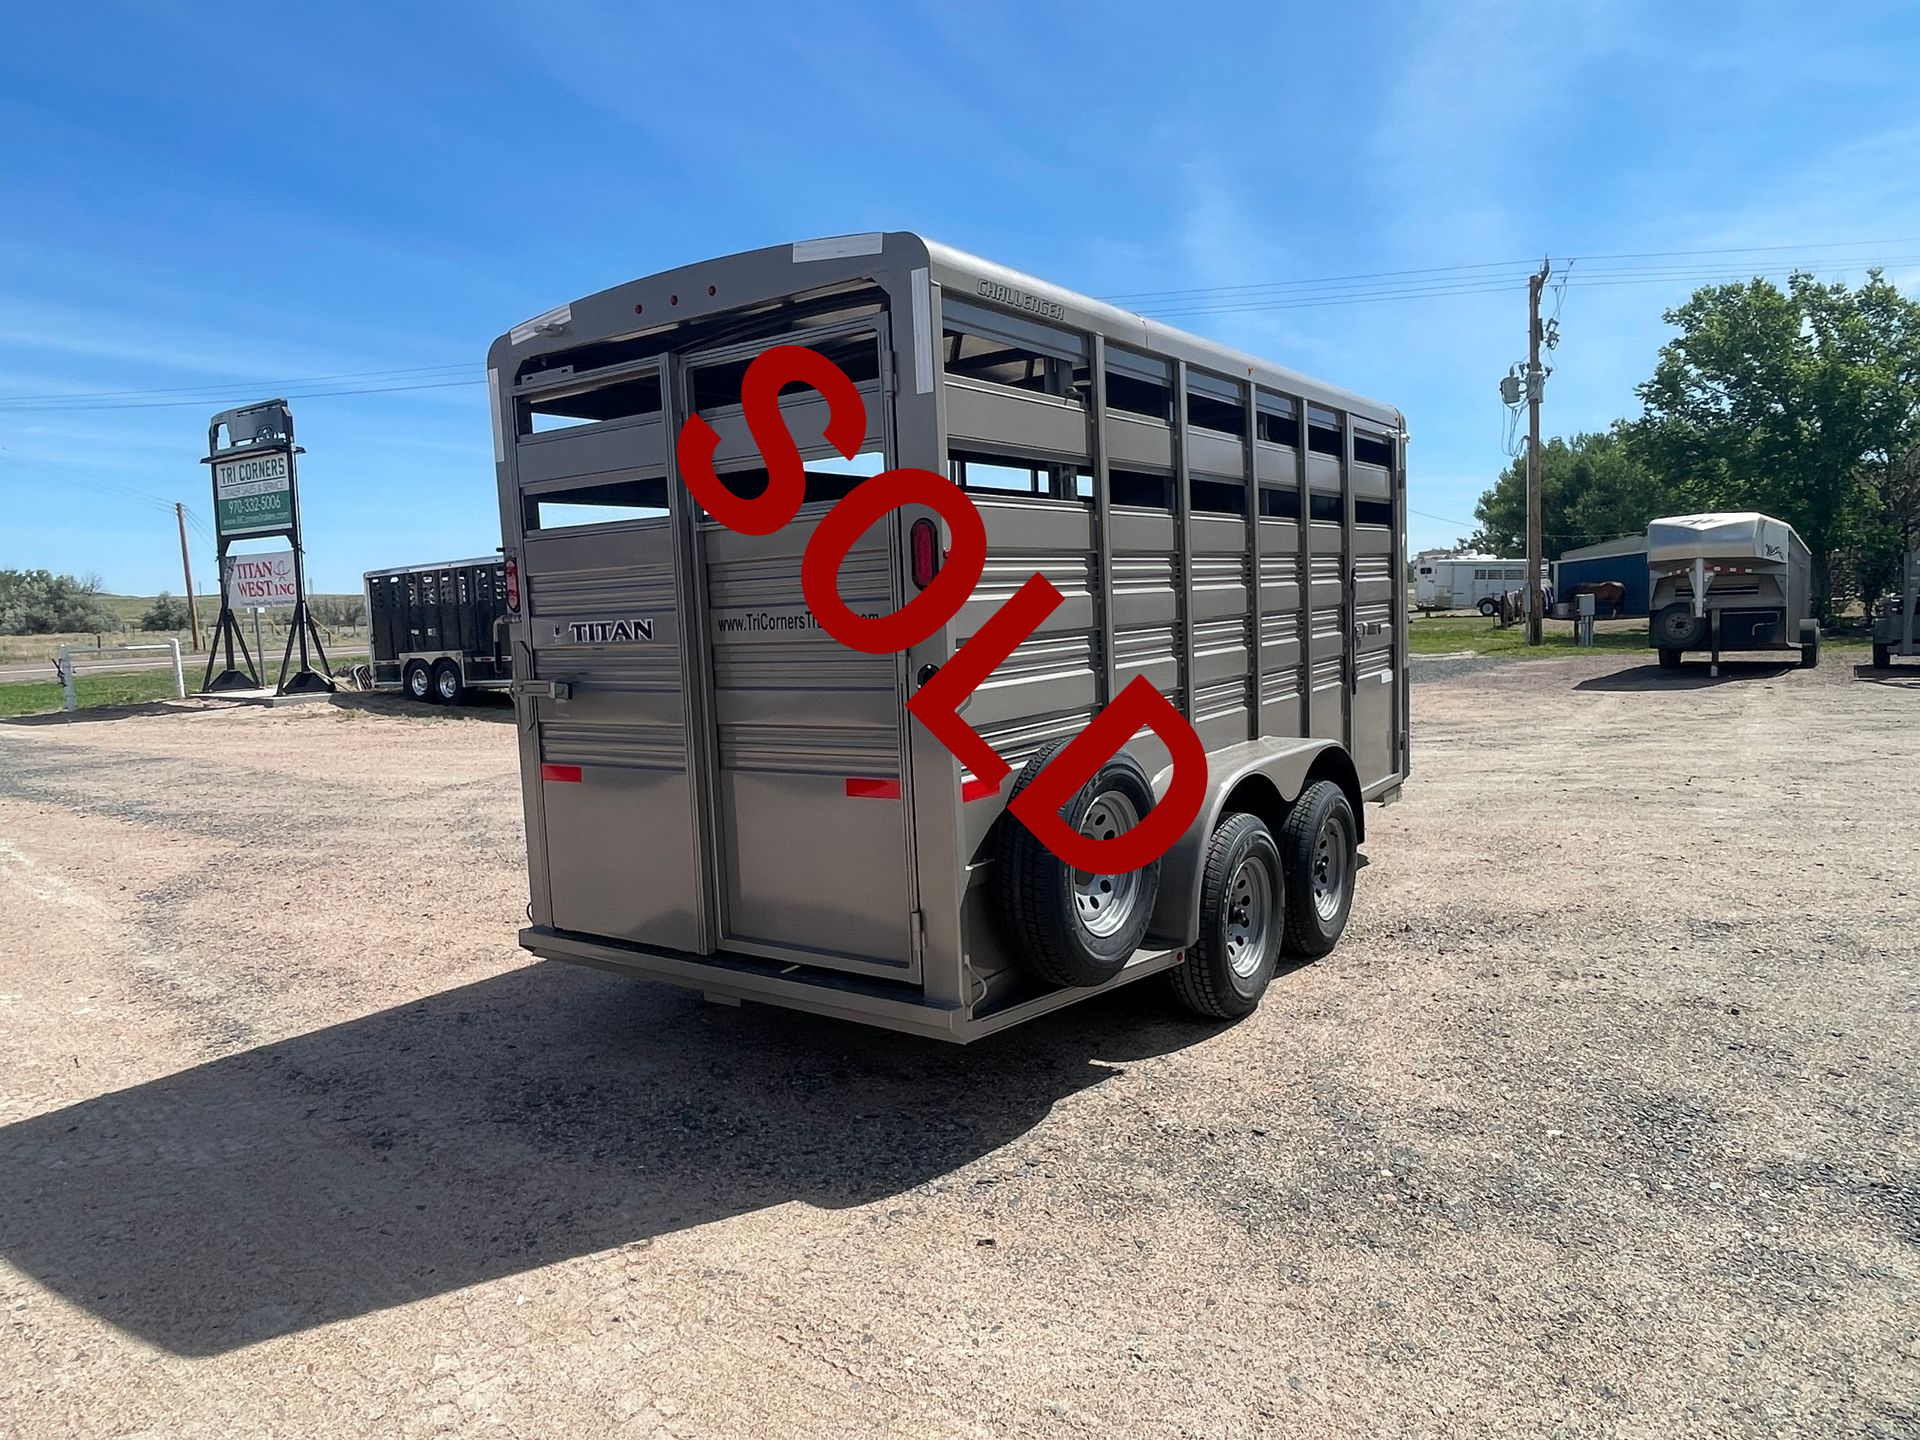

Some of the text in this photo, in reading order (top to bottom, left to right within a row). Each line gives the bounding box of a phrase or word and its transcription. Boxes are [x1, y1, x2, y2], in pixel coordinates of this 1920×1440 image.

[977, 278, 1065, 320] CHALLENGER
[220, 458, 285, 484] TRI CORNERS
[228, 494, 281, 514] 970-332-5006
[236, 561, 273, 579] TITAN
[237, 580, 295, 597] WEST INC
[568, 619, 655, 643] TITAN
[718, 611, 879, 632] www.TriCornersTr
